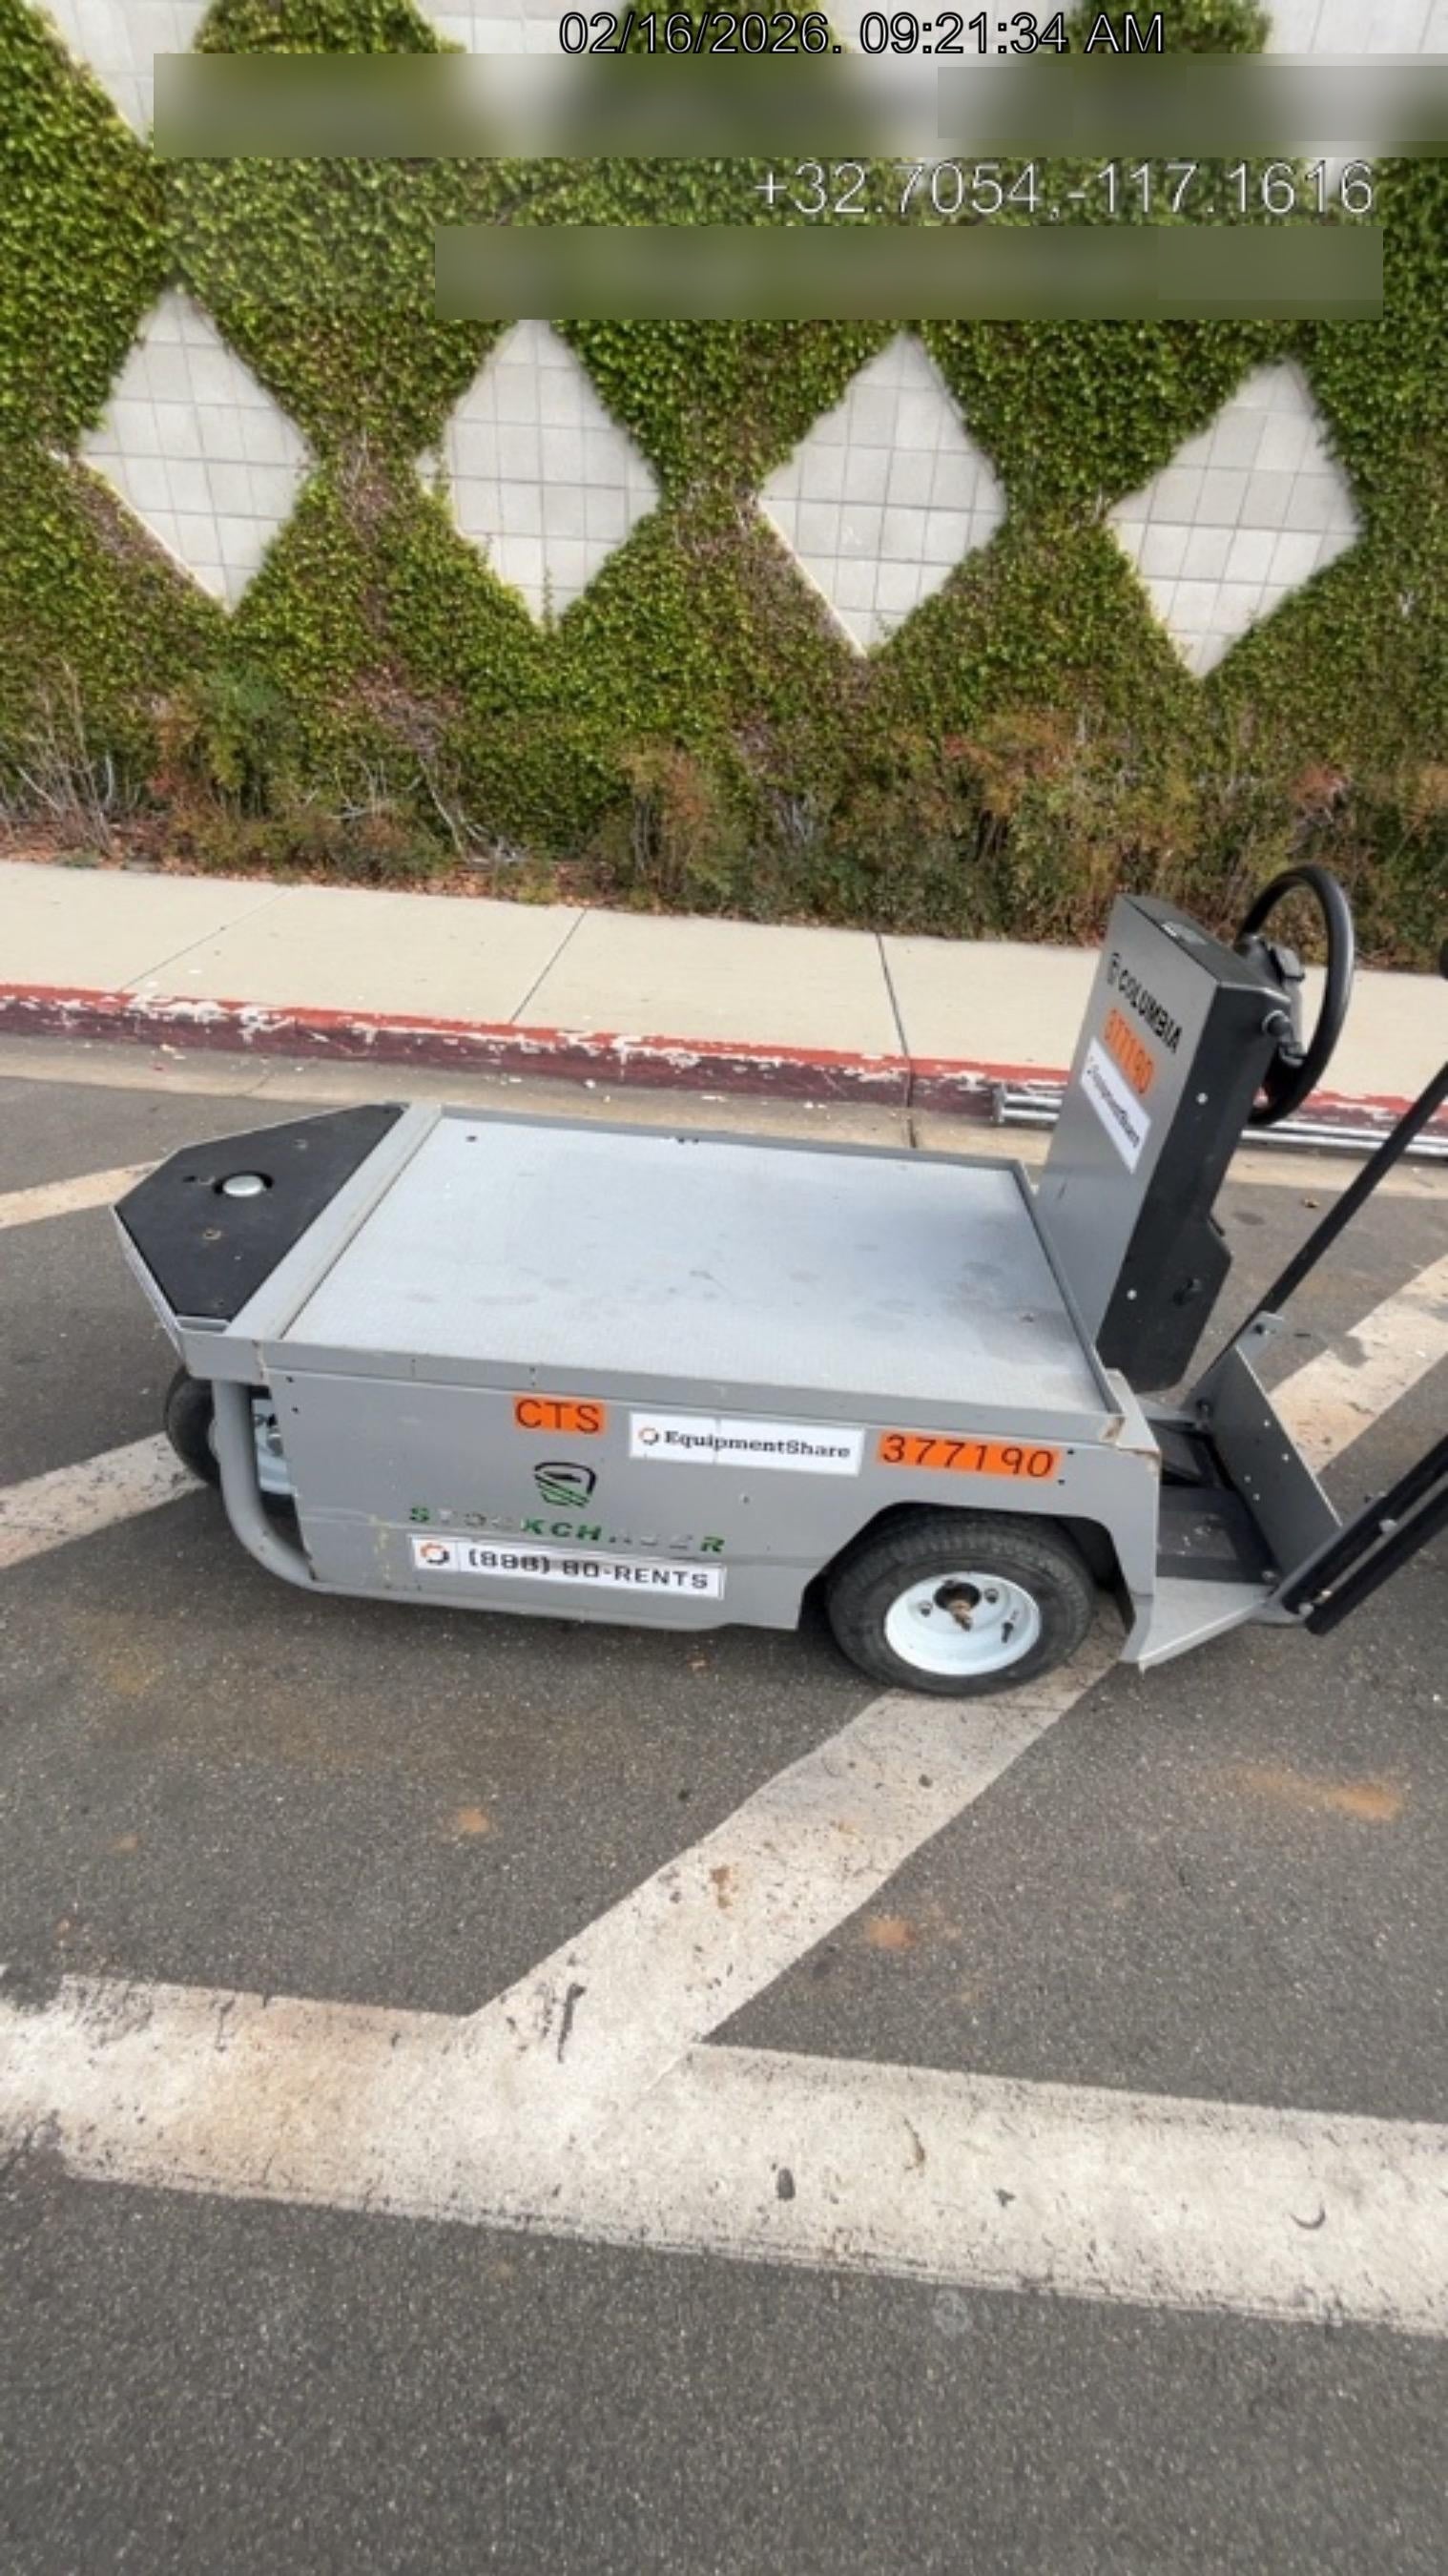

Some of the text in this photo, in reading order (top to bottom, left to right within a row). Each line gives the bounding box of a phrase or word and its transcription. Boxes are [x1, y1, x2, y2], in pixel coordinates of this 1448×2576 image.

[1118, 969, 1182, 1053] COLUMBIA
[514, 1400, 600, 1434] CTS
[665, 1430, 851, 1458] EquipmentShare
[882, 1434, 1054, 1477] 377190
